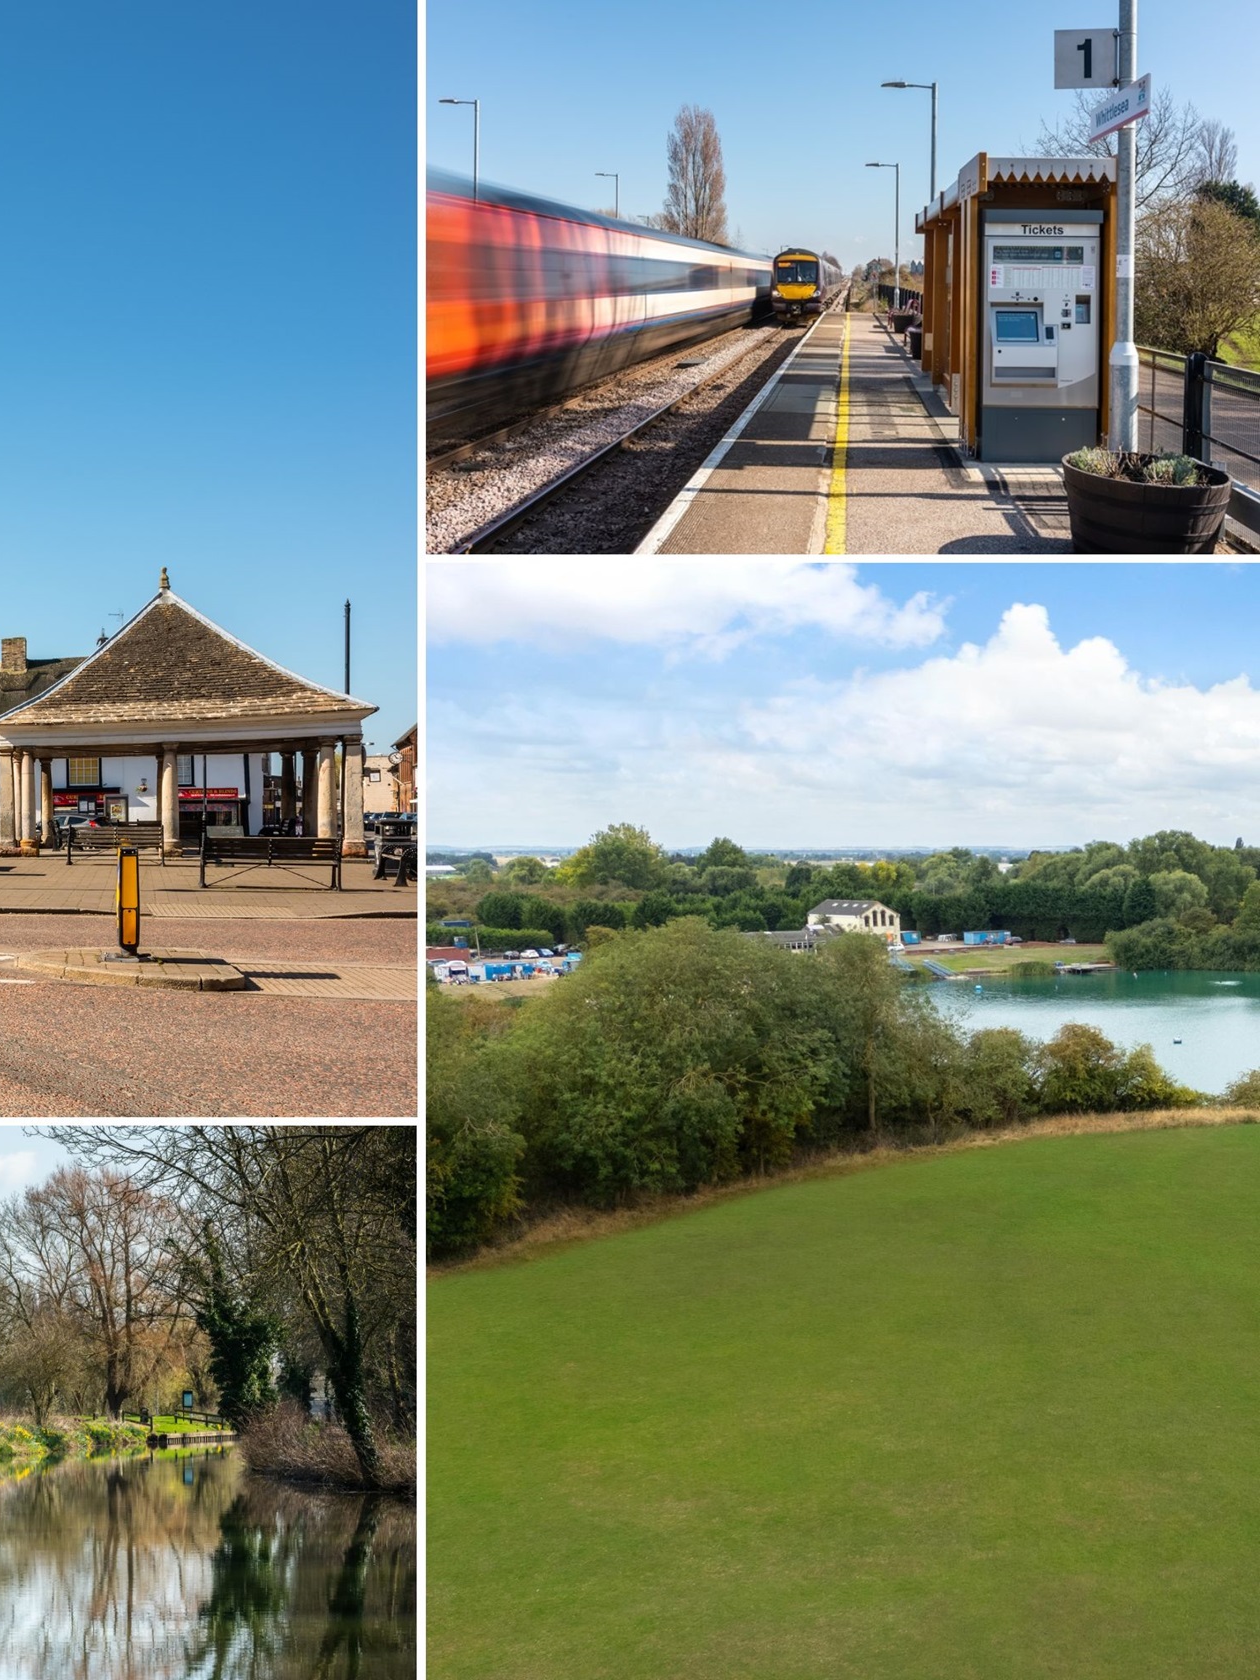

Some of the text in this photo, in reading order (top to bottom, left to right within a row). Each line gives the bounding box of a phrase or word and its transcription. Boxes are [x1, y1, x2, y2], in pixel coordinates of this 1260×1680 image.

[1077, 38, 1092, 78] 1
[1095, 98, 1129, 128] Whittlesea
[1021, 224, 1064, 235] Tickets
